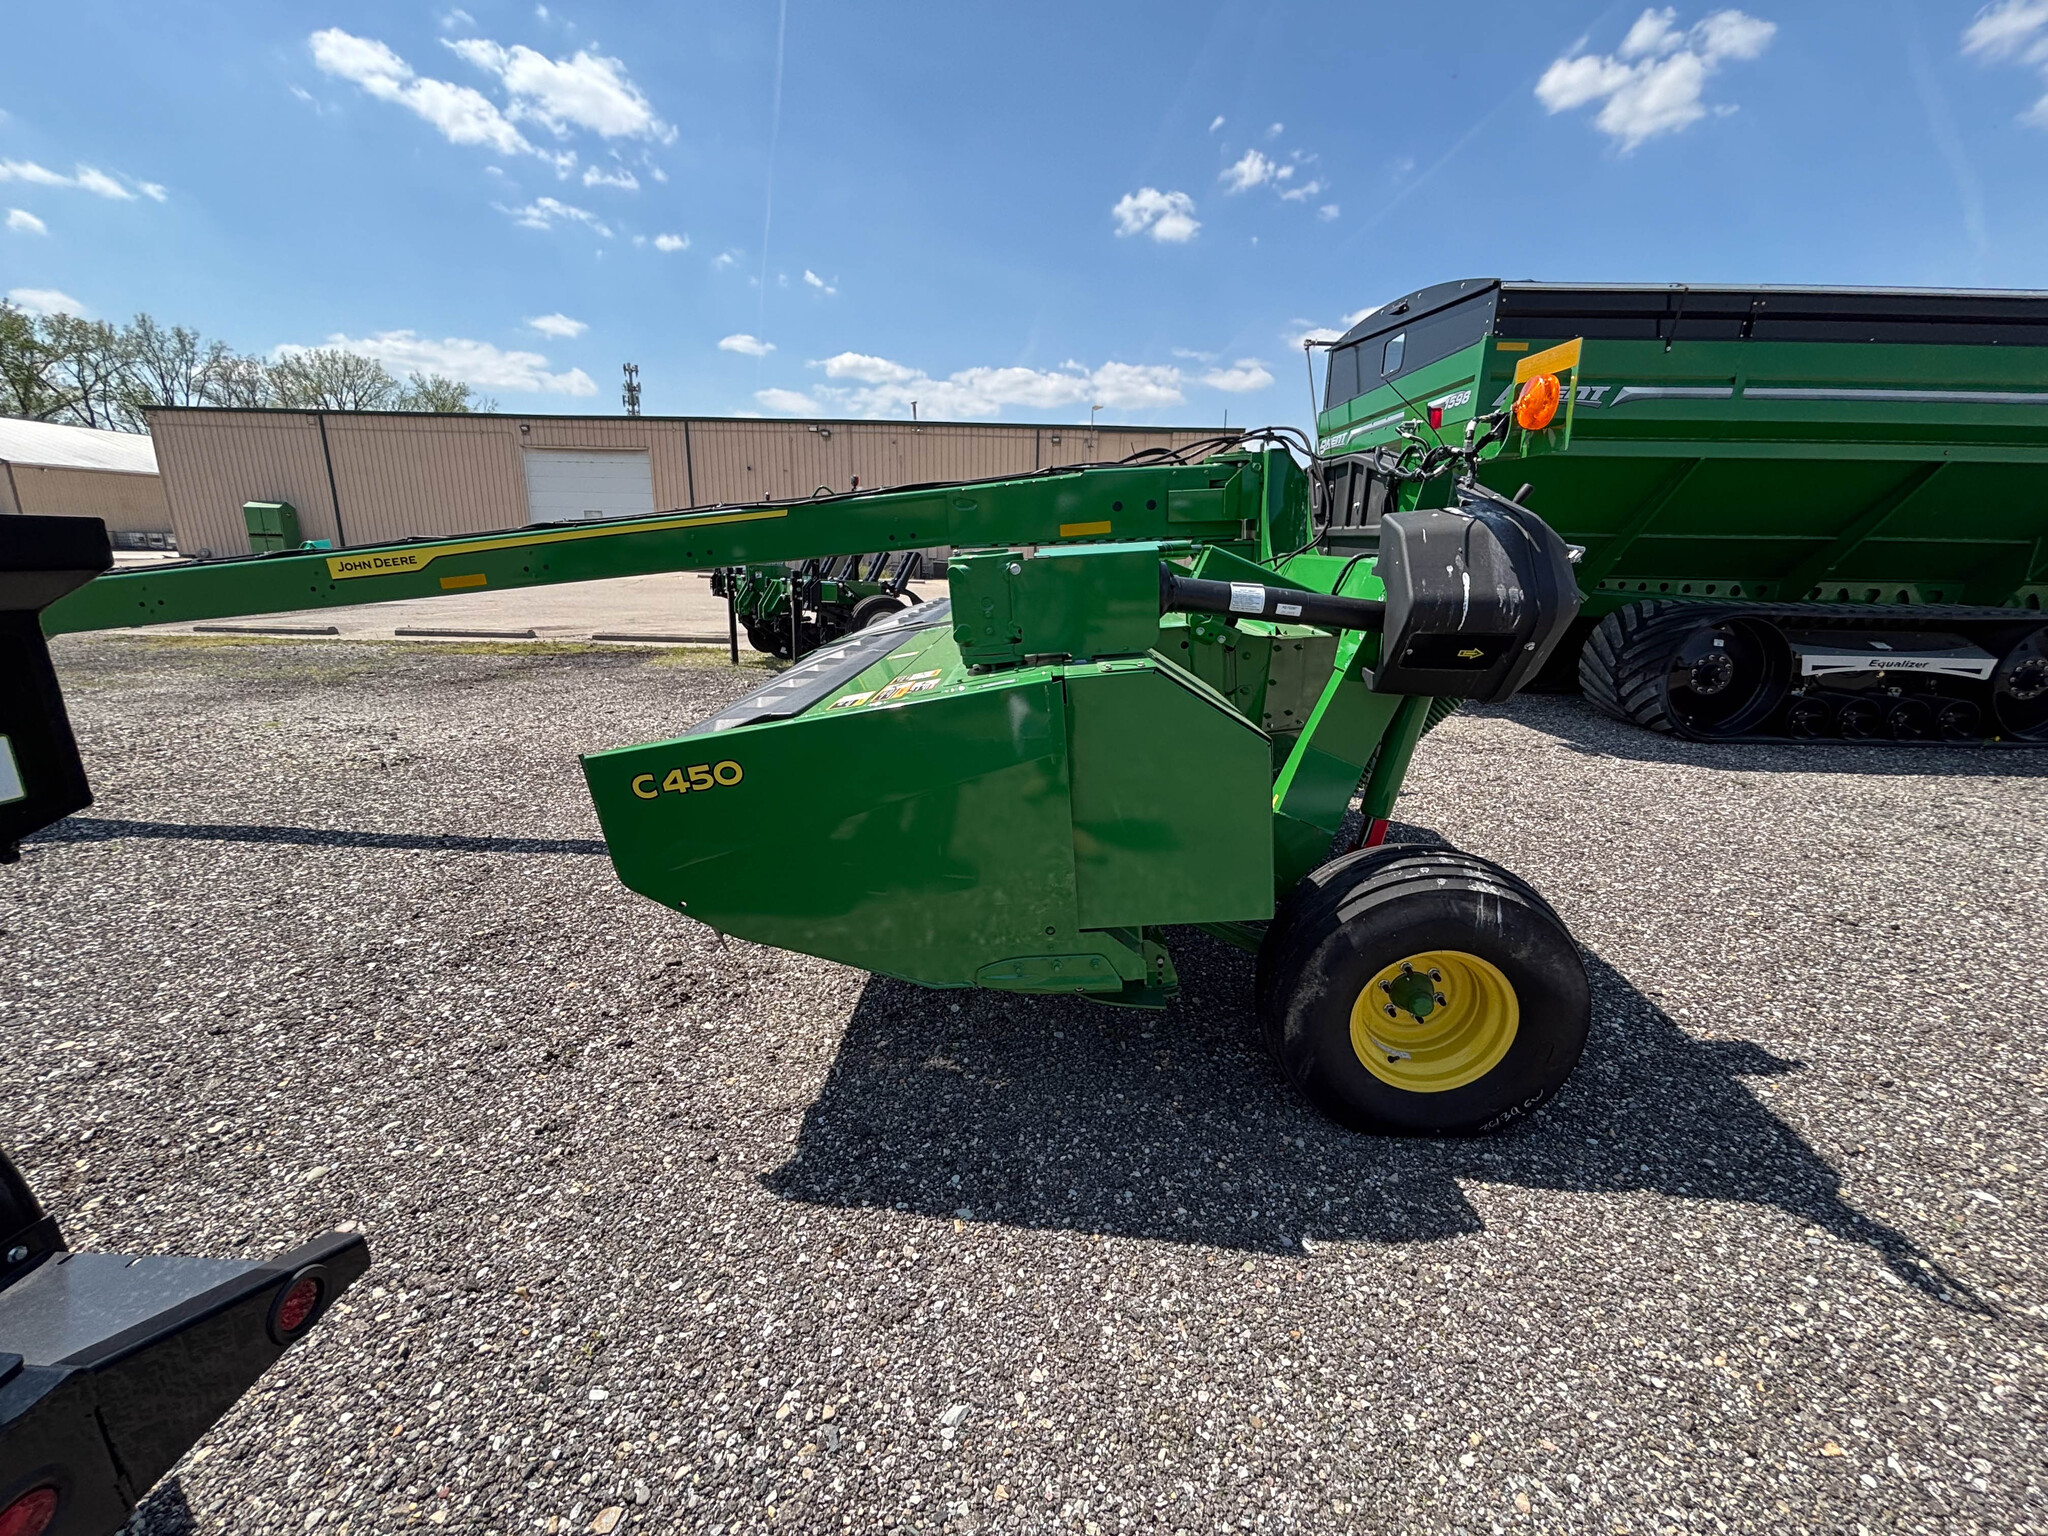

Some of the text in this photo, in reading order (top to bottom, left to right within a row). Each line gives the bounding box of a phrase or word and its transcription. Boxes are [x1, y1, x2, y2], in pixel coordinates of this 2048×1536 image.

[1444, 390, 1472, 410] 1598
[338, 555, 417, 573] JOHN DEERE
[1868, 659, 1930, 669] Equalizer
[631, 759, 744, 800] C 450
